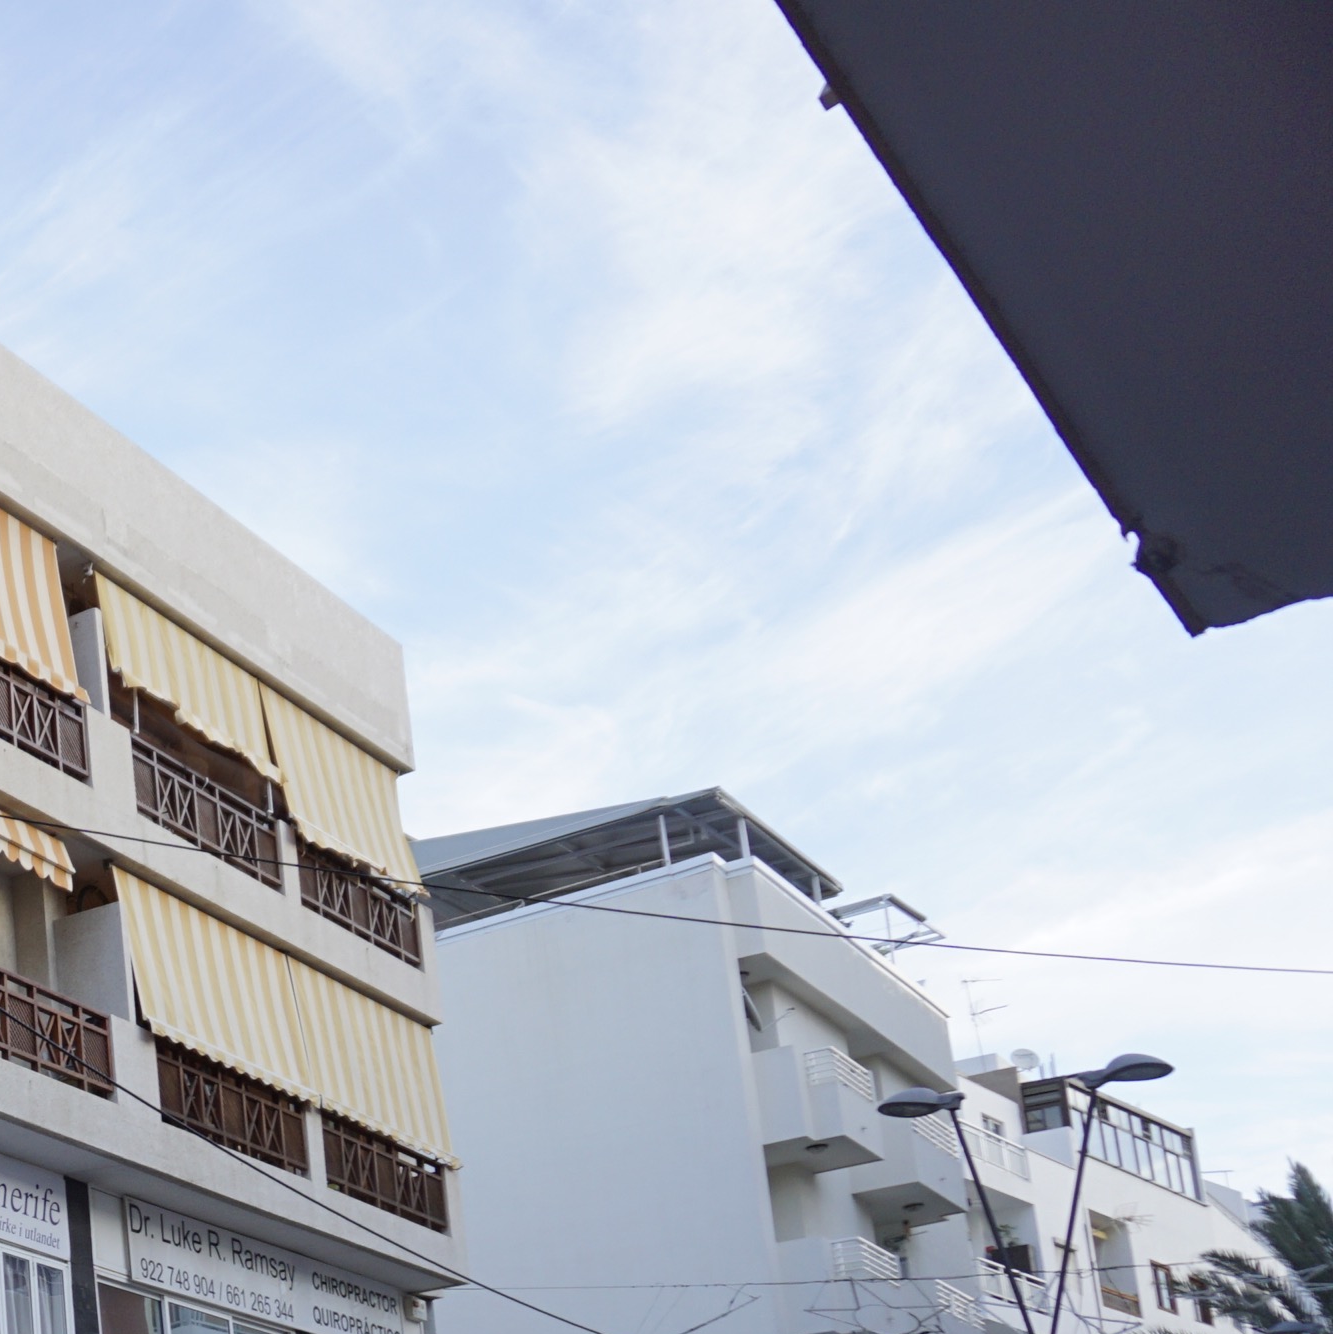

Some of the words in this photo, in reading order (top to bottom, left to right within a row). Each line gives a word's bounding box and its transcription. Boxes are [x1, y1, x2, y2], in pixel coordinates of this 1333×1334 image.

[18, 1221, 24, 1238] i
[24, 1225, 60, 1250] utlandet
[129, 1203, 155, 1239] Dr.
[160, 1213, 202, 1254] Luke
[208, 1228, 227, 1262] R.
[232, 1237, 296, 1291] Ramsay
[140, 1257, 164, 1284] 922
[167, 1266, 190, 1292] 748
[194, 1275, 216, 1299] 904
[226, 1284, 247, 1309] 661
[251, 1292, 272, 1316] 265
[274, 1299, 294, 1323] 344
[312, 1271, 399, 1316] CHIROPRACTOR
